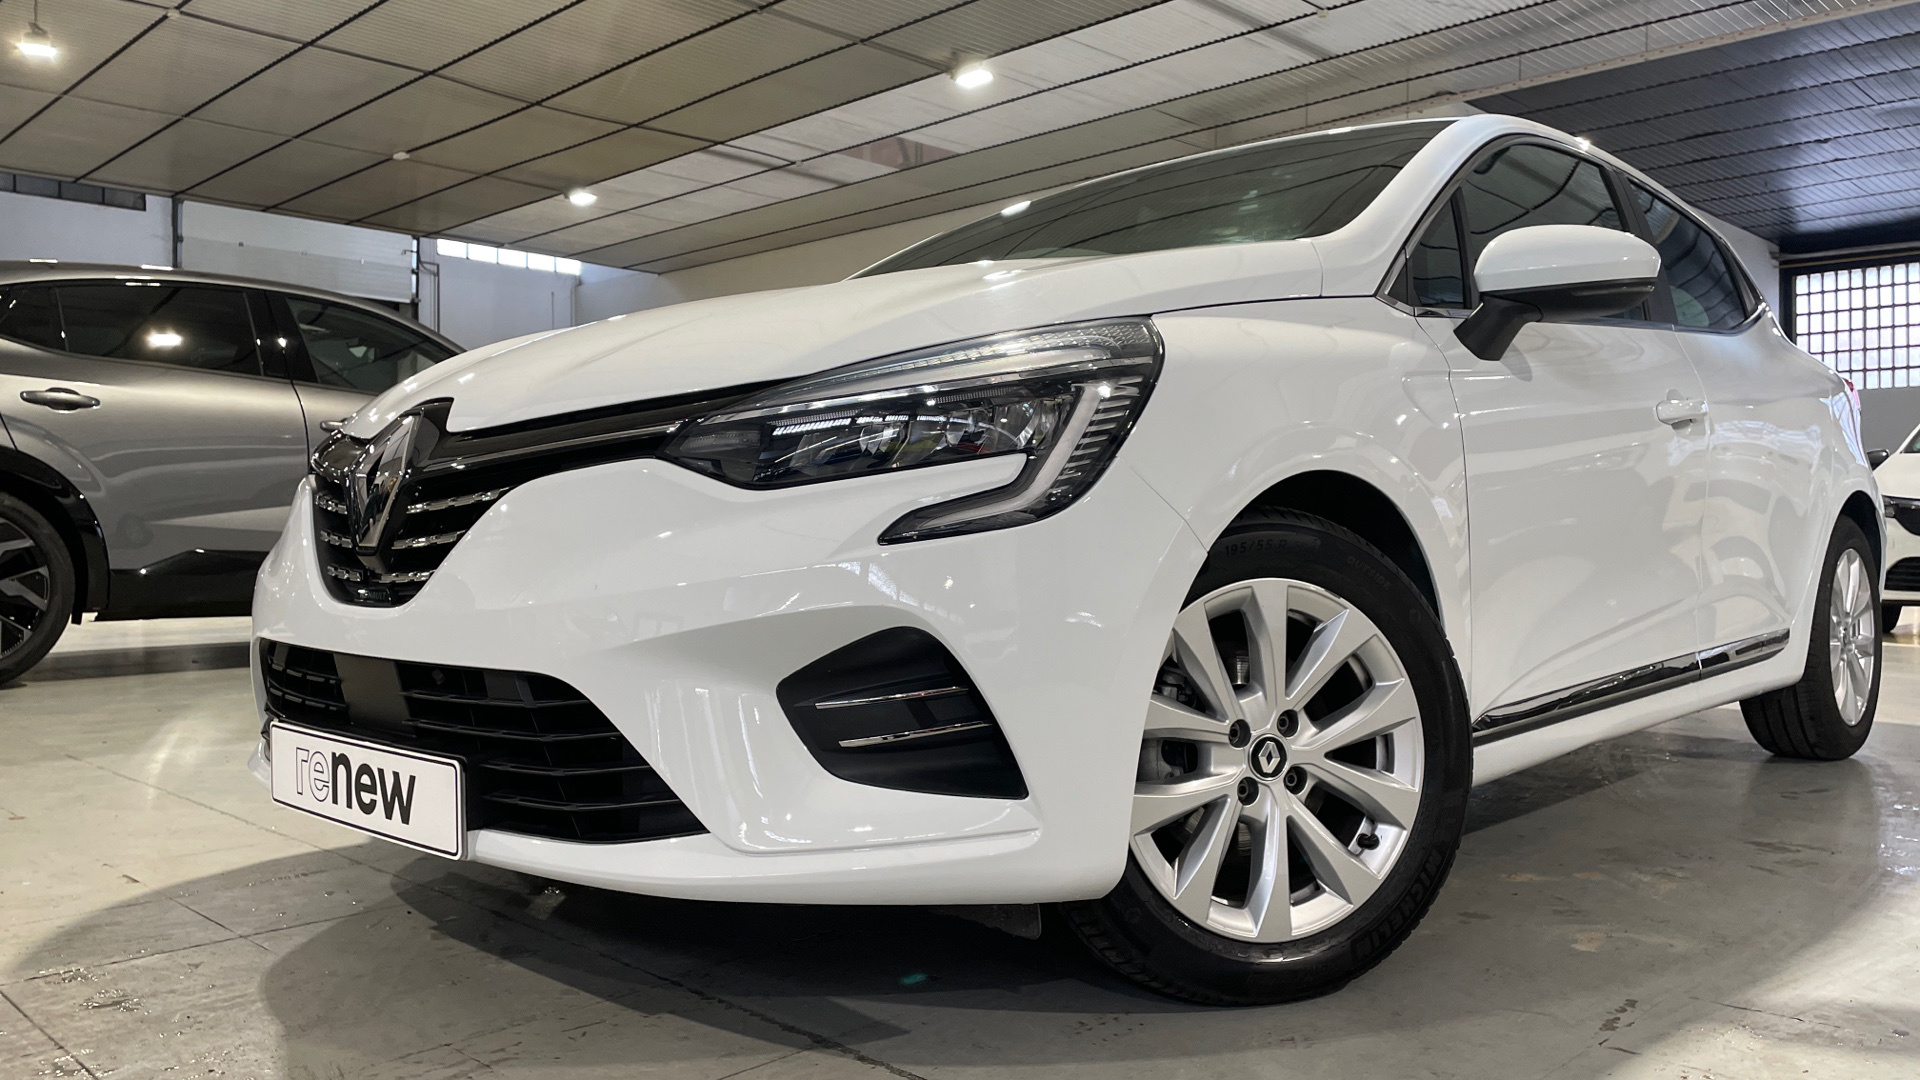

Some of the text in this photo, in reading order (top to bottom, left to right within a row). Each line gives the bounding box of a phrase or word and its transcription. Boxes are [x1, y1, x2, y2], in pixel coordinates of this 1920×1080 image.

[1225, 539, 1273, 556] 195/55
[1347, 555, 1392, 590] OUTSIDE
[295, 747, 416, 825] renew
[1354, 847, 1441, 959] MICHELIN
